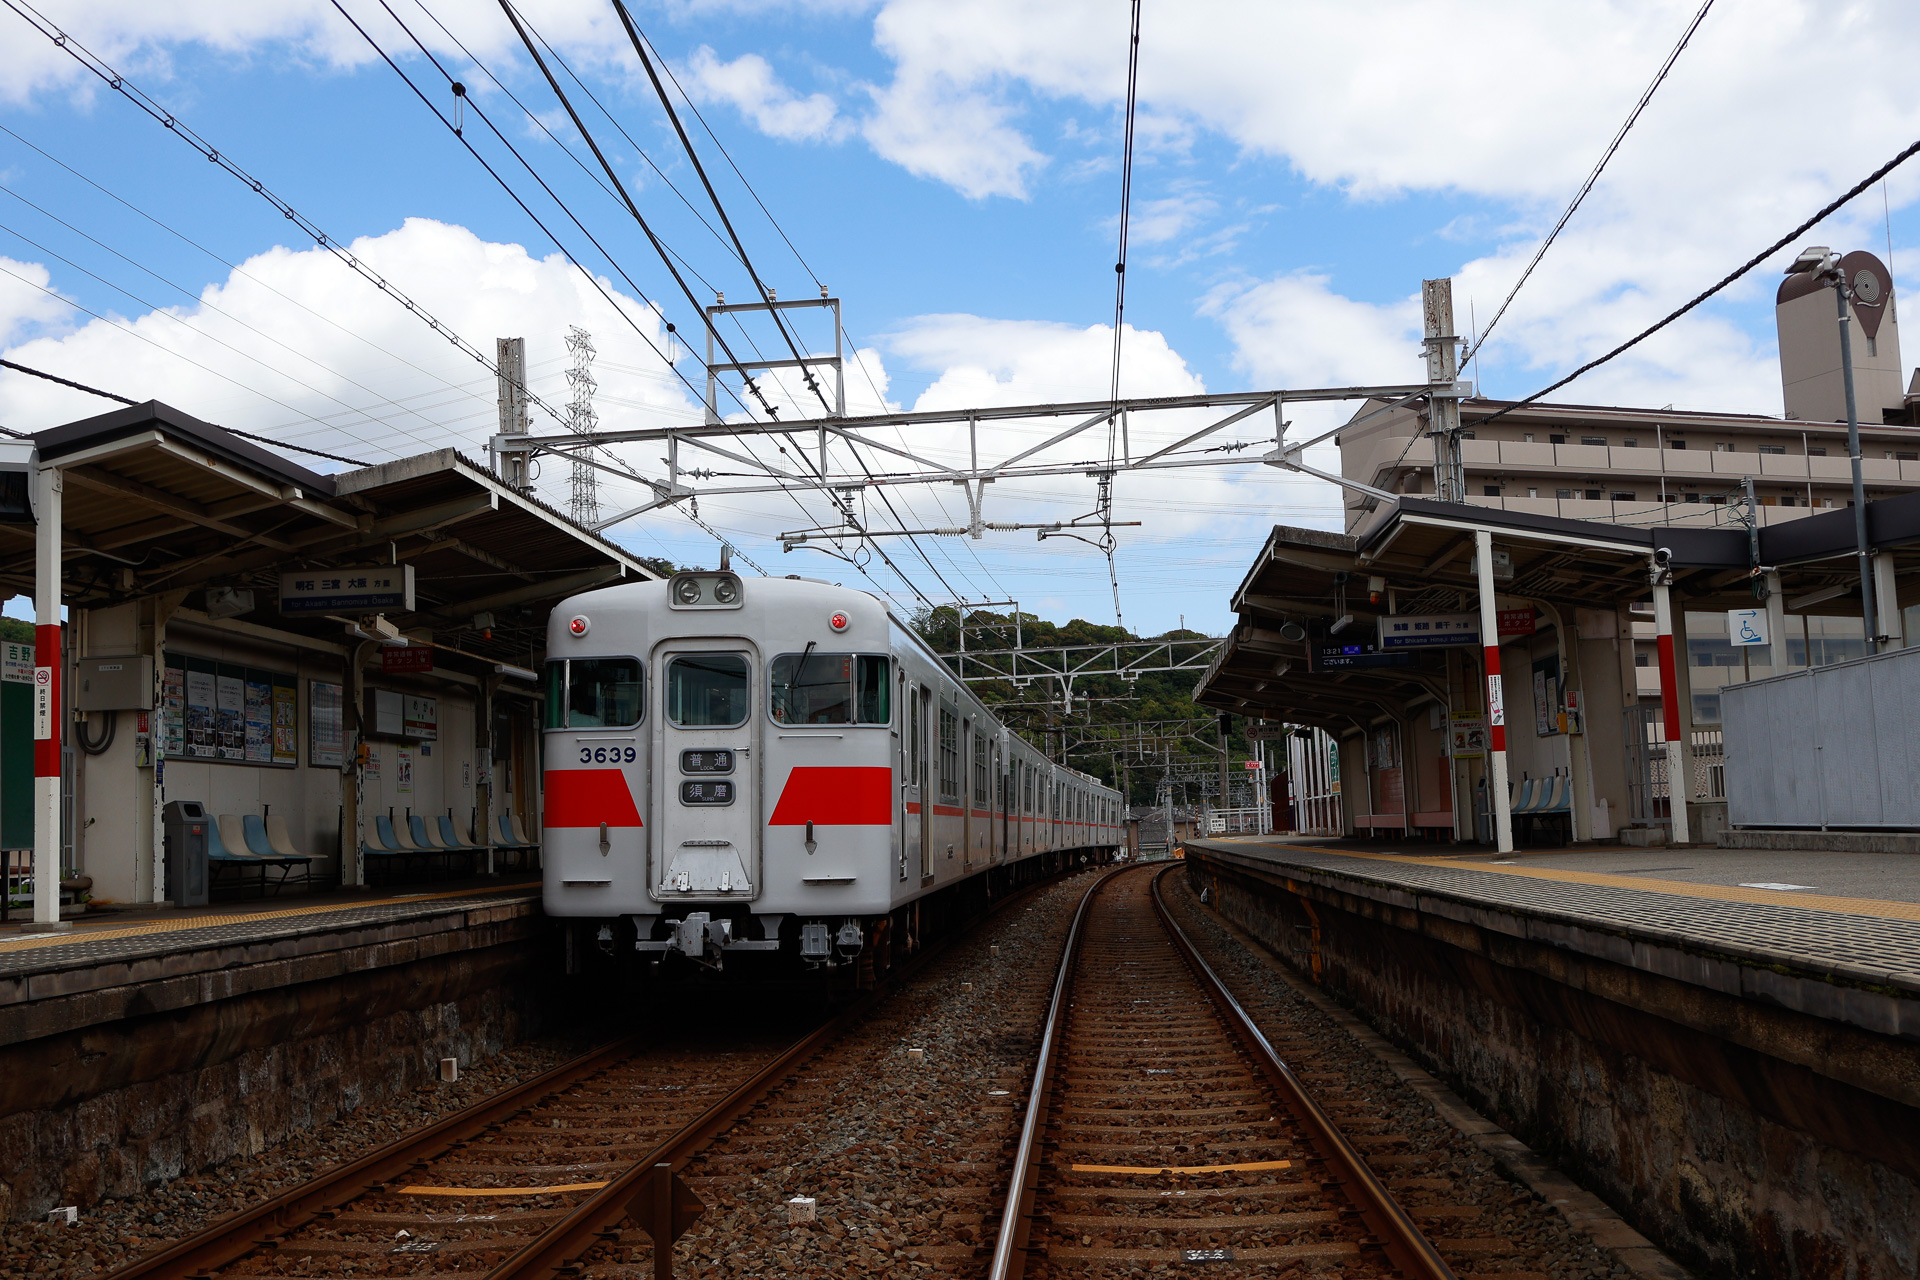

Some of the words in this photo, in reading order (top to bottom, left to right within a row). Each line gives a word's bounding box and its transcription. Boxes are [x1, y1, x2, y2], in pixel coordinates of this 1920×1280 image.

[296, 580, 314, 591] 明石
[322, 579, 340, 589] 三宮
[348, 578, 367, 588] 大阪
[292, 600, 301, 608] for
[332, 598, 368, 606] Sannomiya
[9, 645, 36, 662] 吉野
[580, 747, 636, 763] 3639
[690, 753, 727, 767] 普通
[689, 784, 727, 797] 須磨
